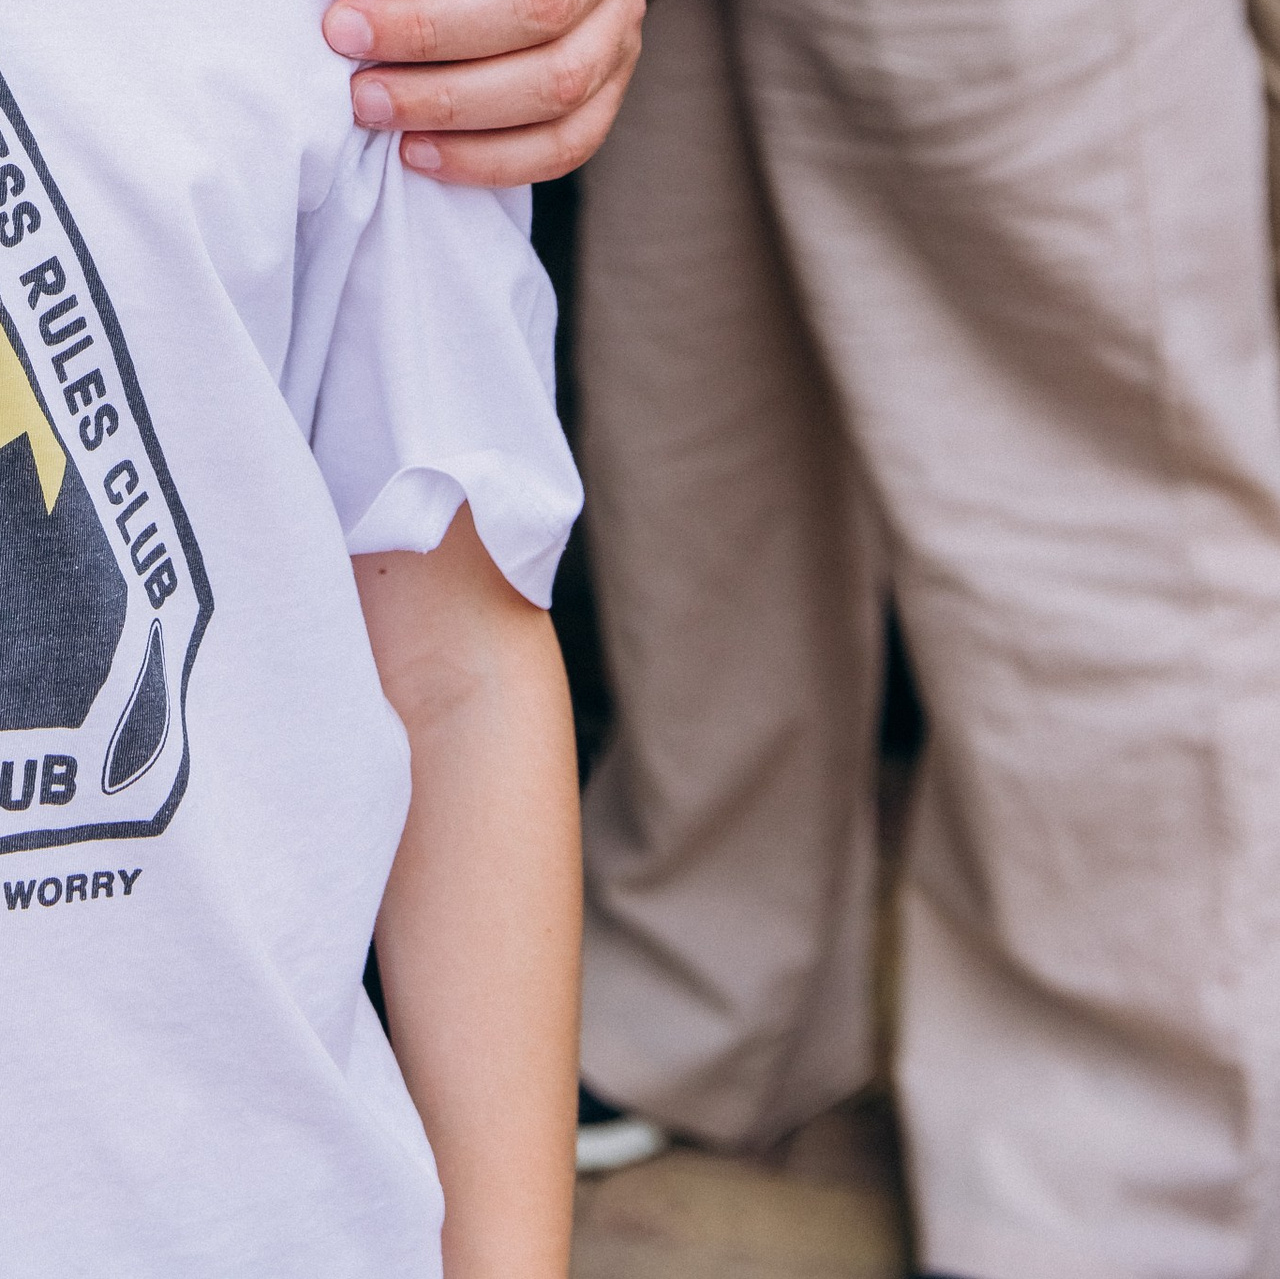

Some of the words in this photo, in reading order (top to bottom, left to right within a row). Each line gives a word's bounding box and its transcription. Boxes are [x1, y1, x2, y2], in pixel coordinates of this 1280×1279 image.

[18, 255, 120, 452] RULES
[102, 459, 179, 611] CLUB
[3, 867, 142, 910] WORRY
